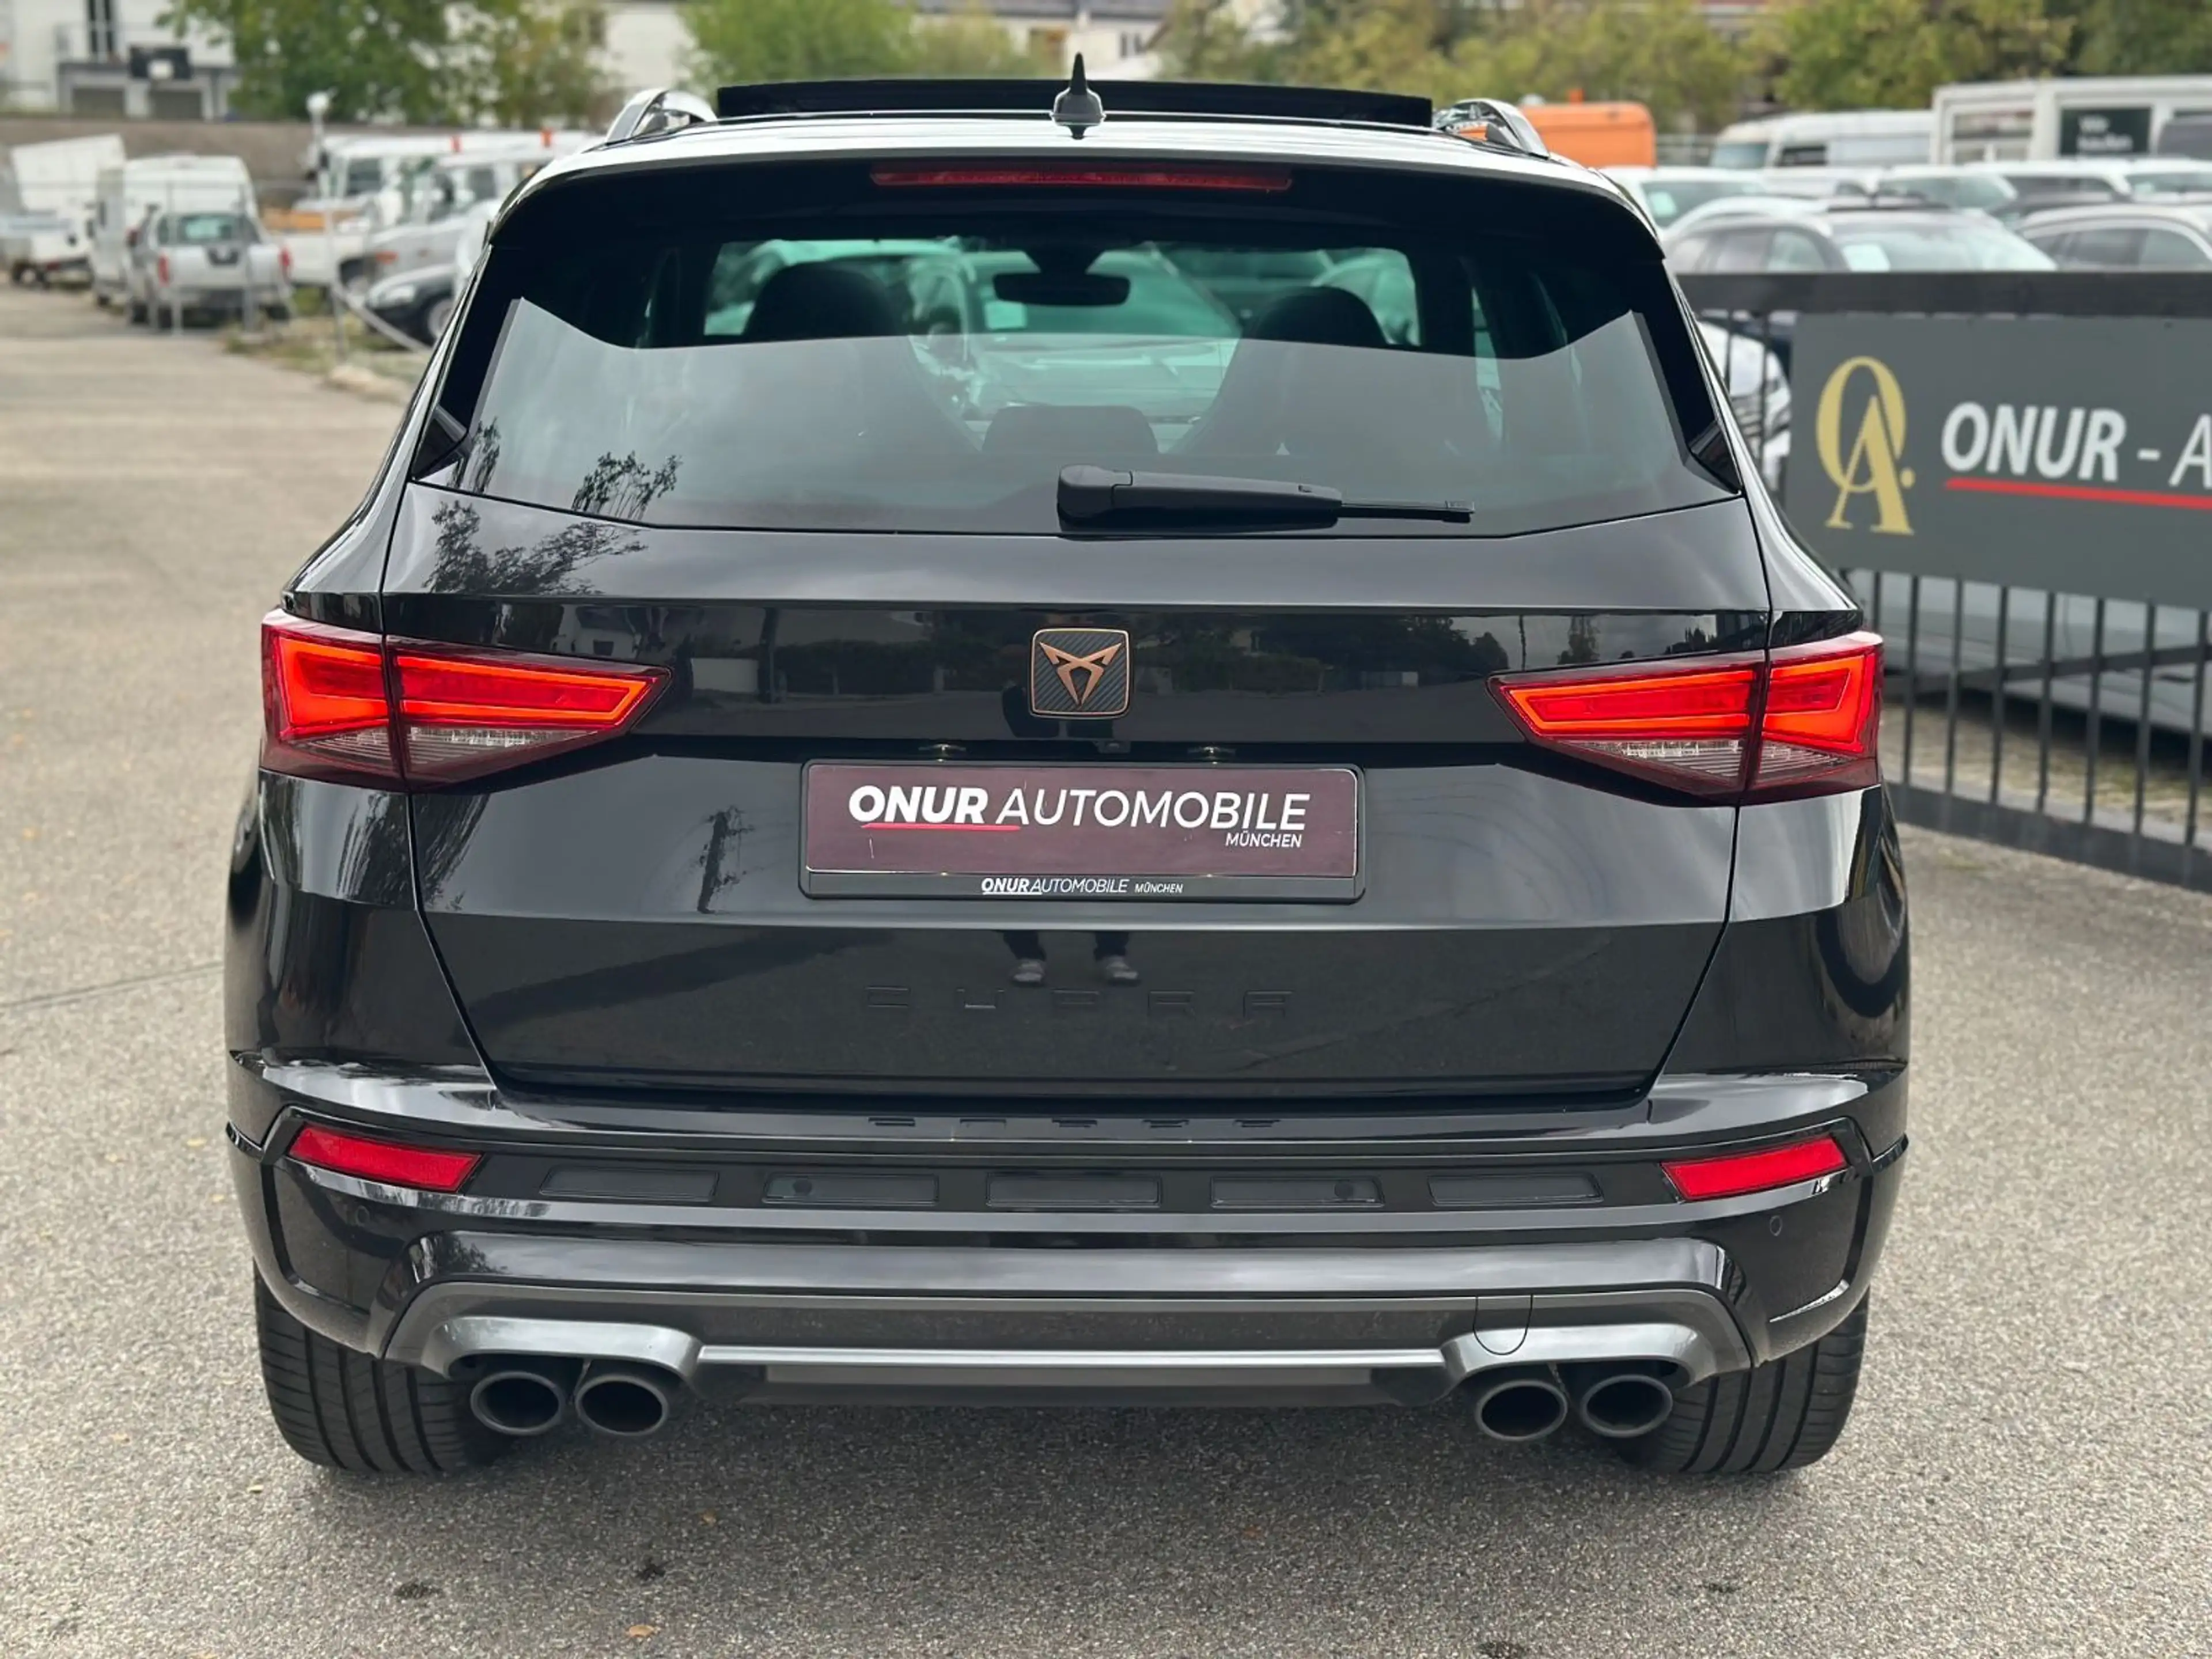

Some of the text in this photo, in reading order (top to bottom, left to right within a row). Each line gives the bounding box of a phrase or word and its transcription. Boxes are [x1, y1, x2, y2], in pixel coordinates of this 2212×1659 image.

[1942, 402, 2126, 482] ONUR
[848, 785, 1311, 831] ONUR AUTOMOBILE
[1225, 830, 1302, 849] MÜNCHEN
[1134, 881, 1184, 894] MÜNCHEN
